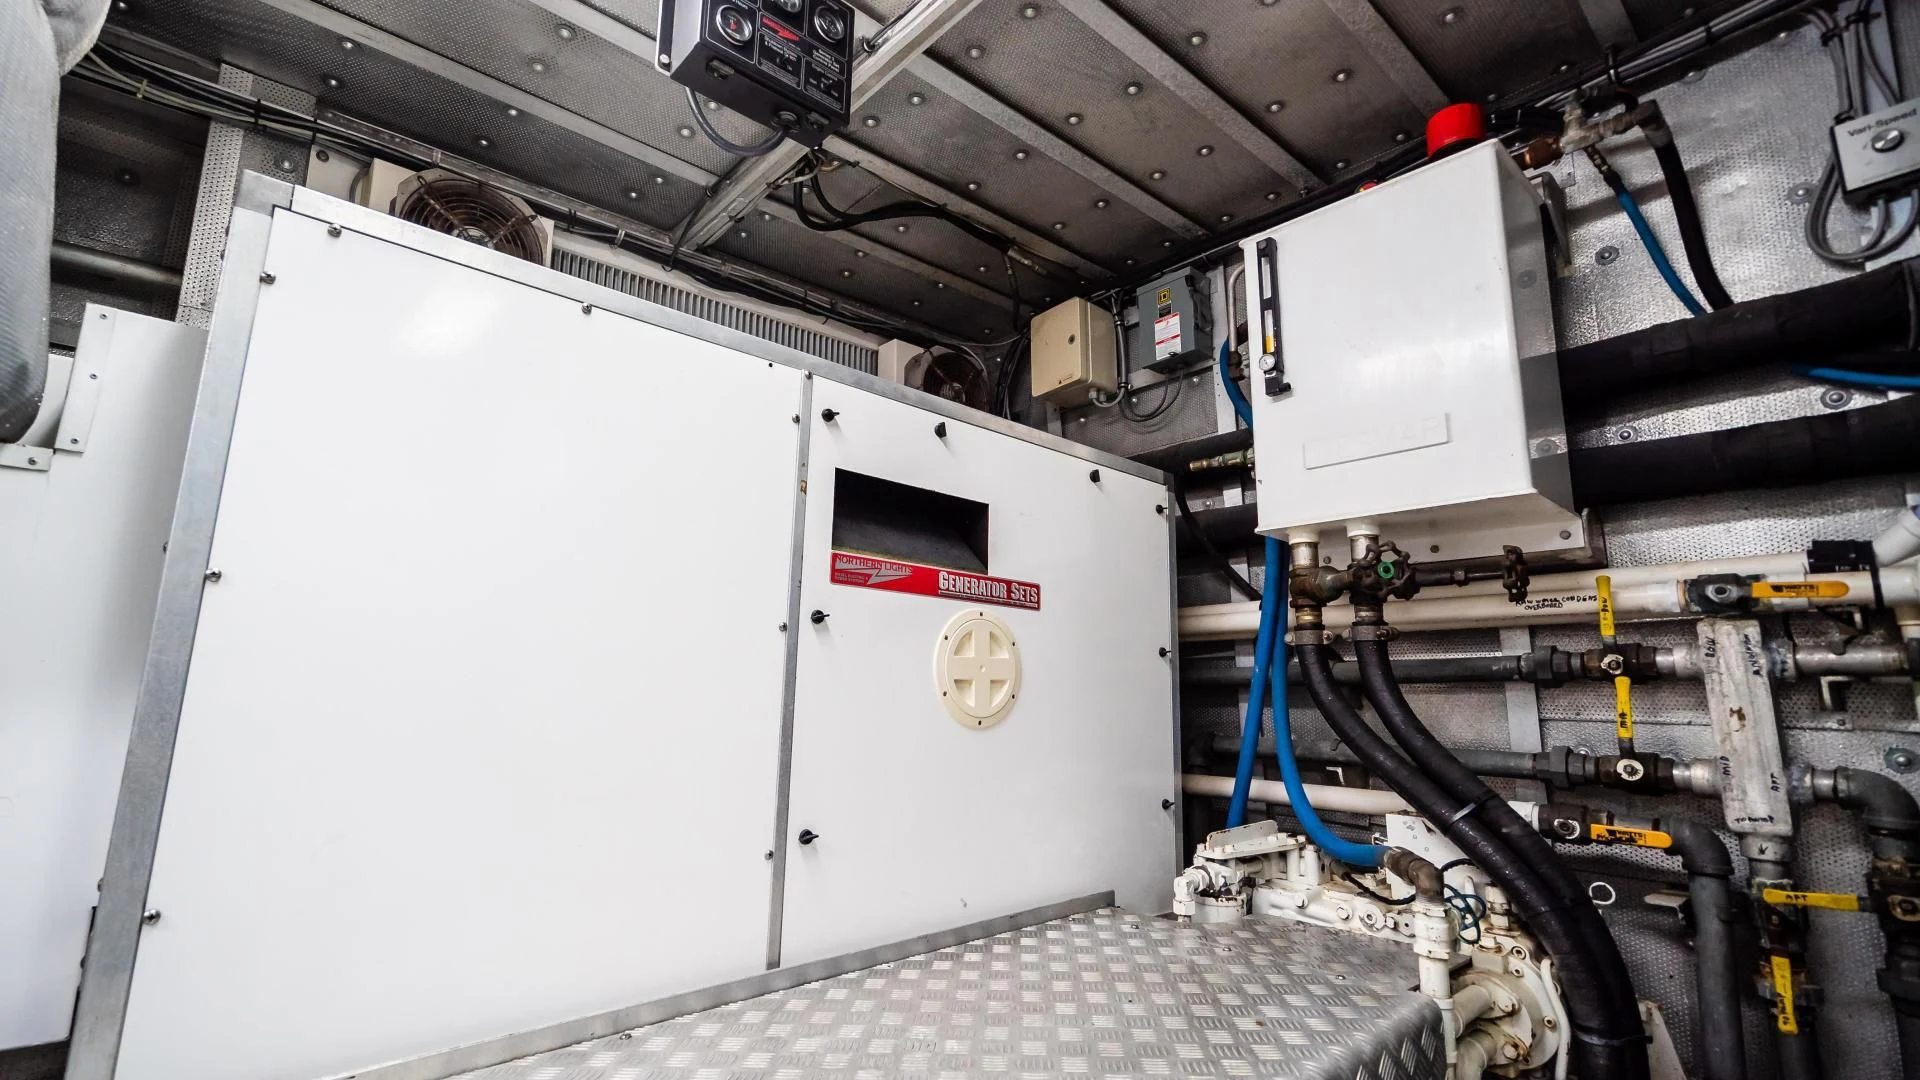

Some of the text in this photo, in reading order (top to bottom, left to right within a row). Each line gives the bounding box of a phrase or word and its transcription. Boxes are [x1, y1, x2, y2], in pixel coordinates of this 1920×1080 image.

[1847, 108, 1917, 137] Vari-Speed
[836, 555, 913, 574] NORTHERN LIGHTS
[1720, 755, 1732, 777] MID
[1769, 771, 1781, 793] AFT
[1785, 894, 1808, 902] AFT
